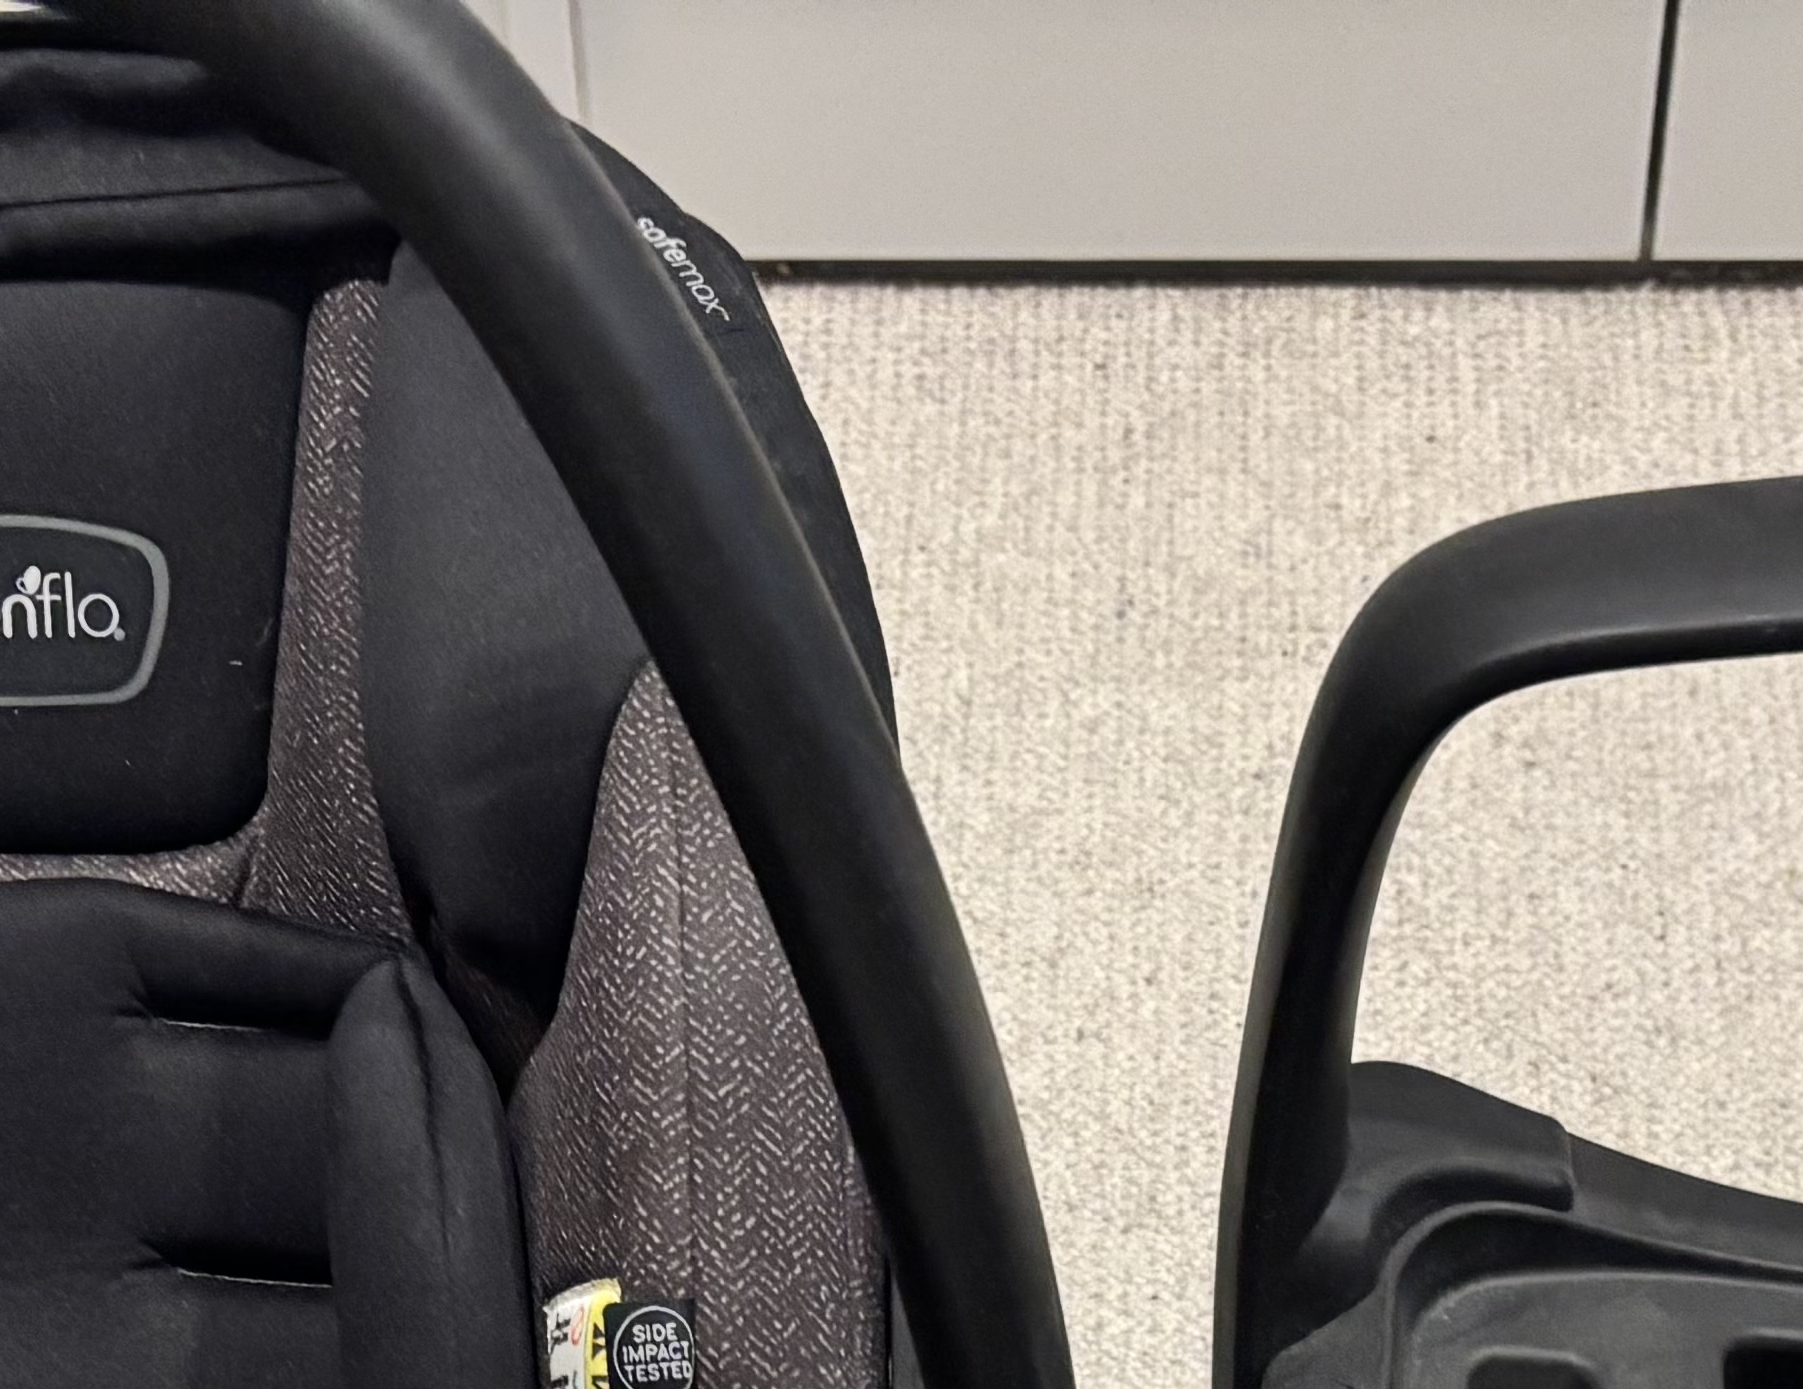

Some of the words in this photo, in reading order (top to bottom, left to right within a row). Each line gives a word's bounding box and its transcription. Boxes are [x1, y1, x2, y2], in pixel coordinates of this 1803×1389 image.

[637, 217, 730, 321] safemax
[632, 1322, 678, 1343] SIDE
[622, 1340, 690, 1364] IMPACT
[624, 1360, 693, 1382] TESTED
